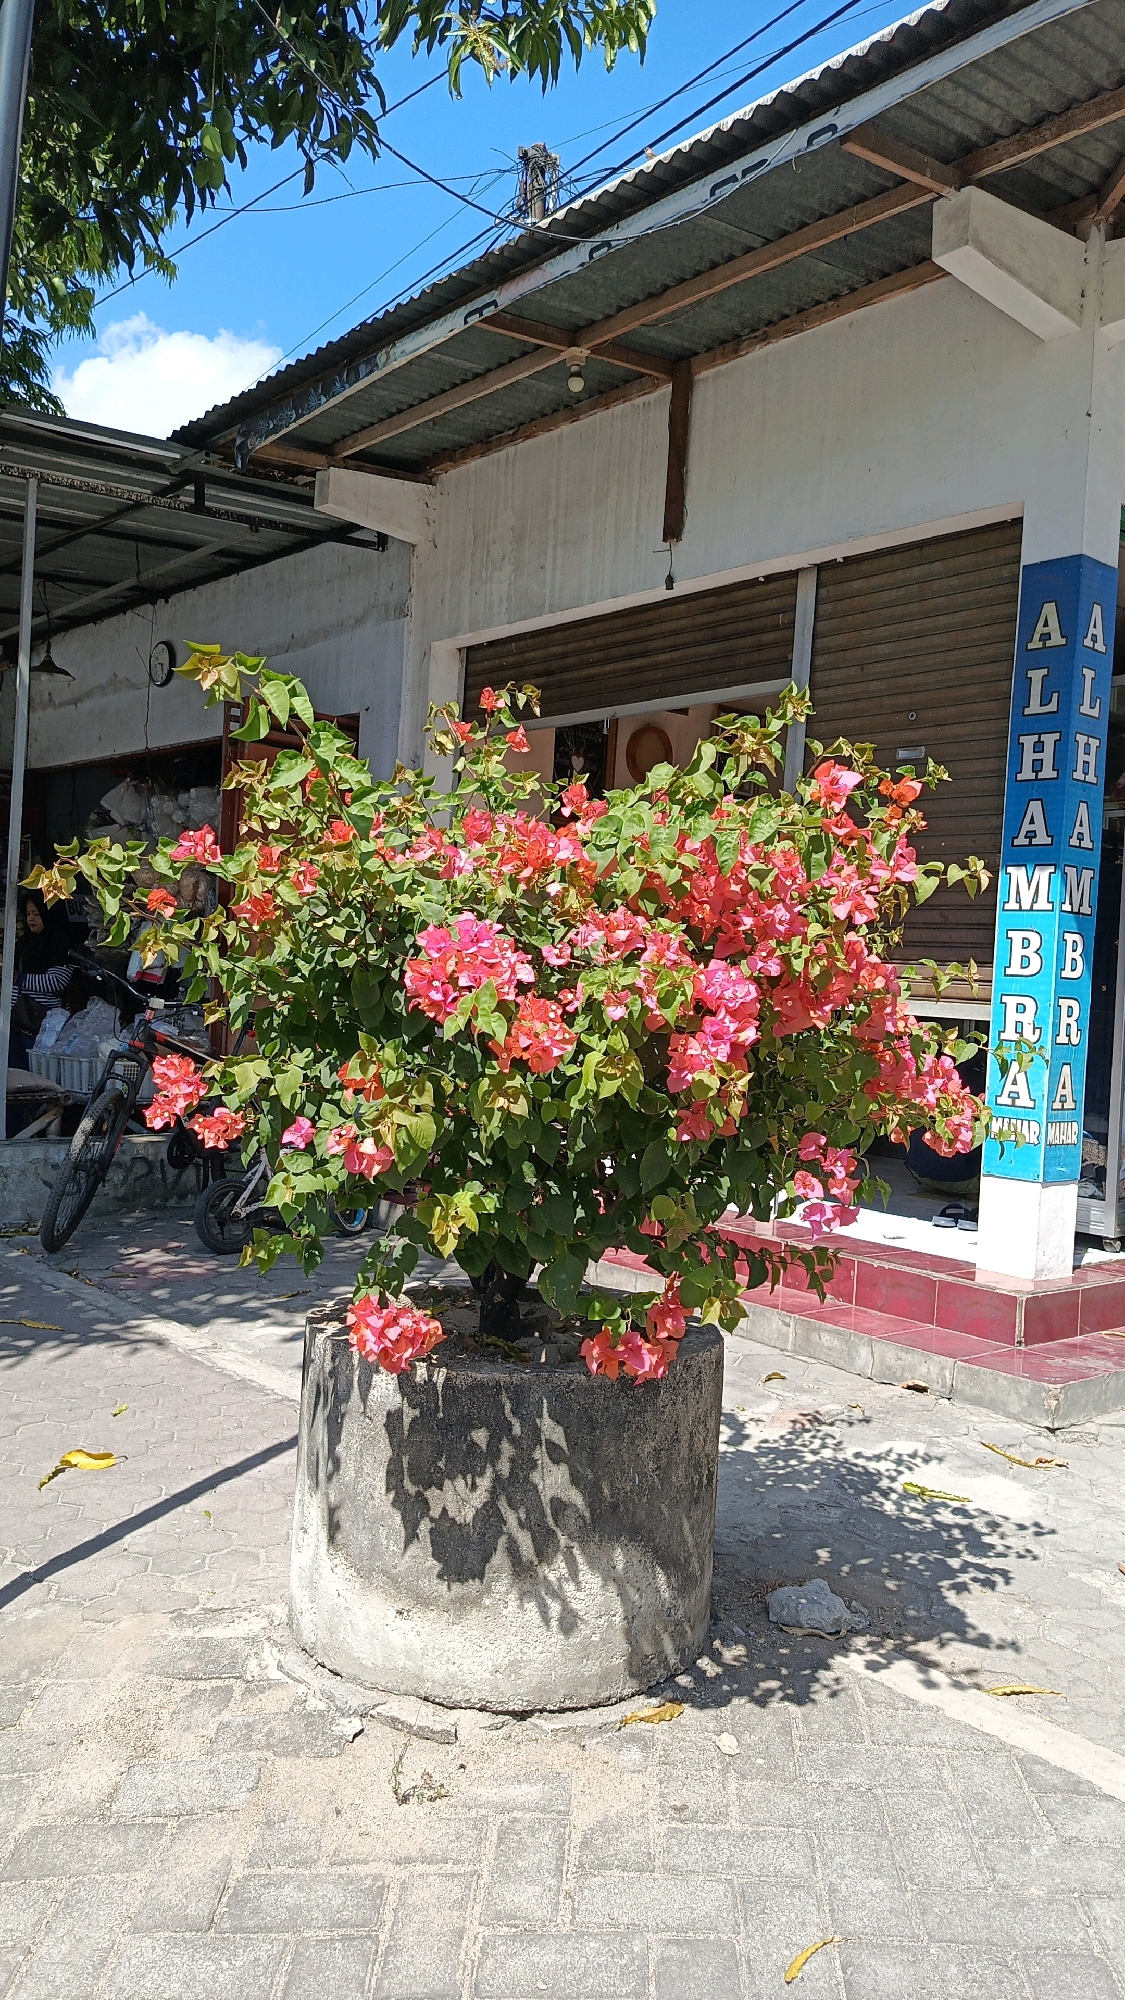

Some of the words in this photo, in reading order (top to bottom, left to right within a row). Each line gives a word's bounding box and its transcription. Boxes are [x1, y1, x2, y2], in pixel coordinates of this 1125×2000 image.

[995, 600, 1068, 1109] ALHAMBRA
[1051, 601, 1107, 1110] ALHAMBRA
[1047, 1121, 1079, 1146] MAHAR
